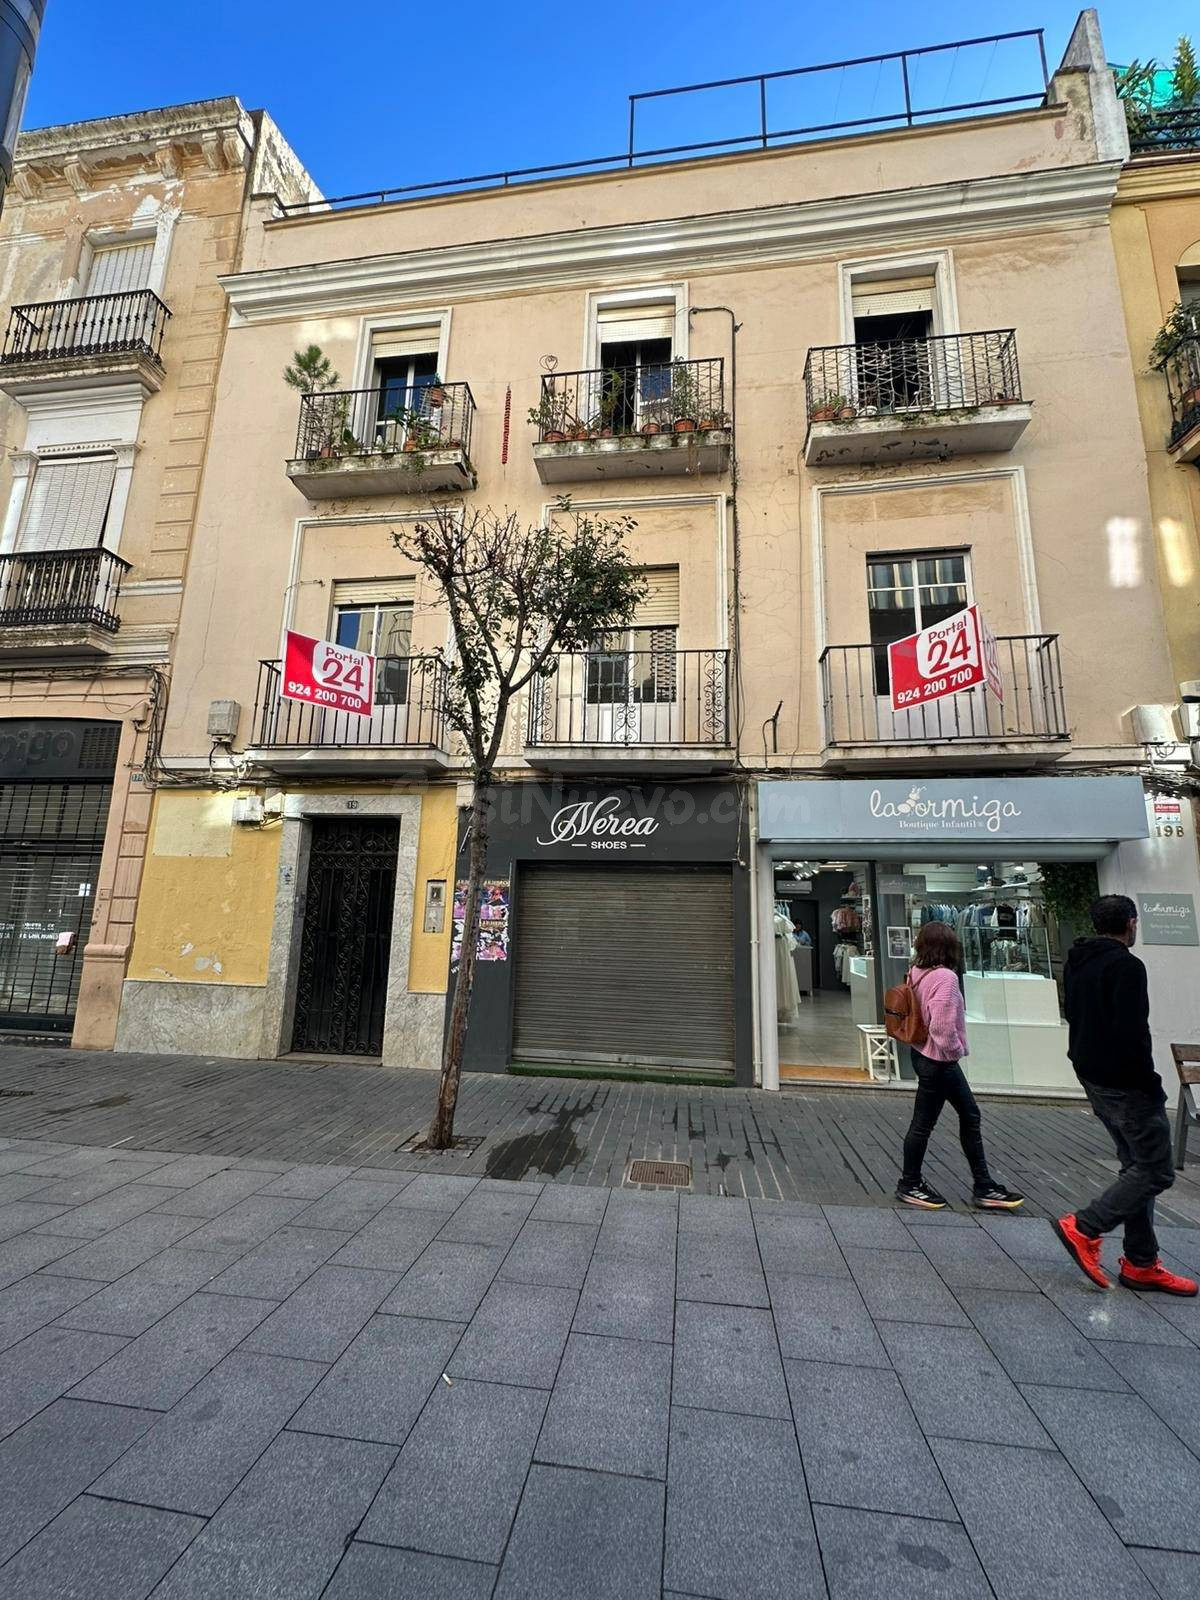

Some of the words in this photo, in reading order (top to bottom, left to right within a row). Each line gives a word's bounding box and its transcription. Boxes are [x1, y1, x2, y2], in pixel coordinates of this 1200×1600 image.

[928, 615, 967, 644] Portal
[326, 646, 364, 666] Portal
[927, 628, 971, 675] 24
[322, 657, 364, 692] 24
[897, 688, 921, 704] 924
[923, 677, 947, 696] 200
[950, 667, 973, 687] 700
[288, 681, 312, 697] 924
[315, 688, 337, 703] 200
[340, 694, 362, 709] 700
[536, 796, 659, 846] Nerea
[899, 820, 938, 830] Boutique
[941, 820, 977, 829] Infantil
[591, 840, 627, 850] SHOES
